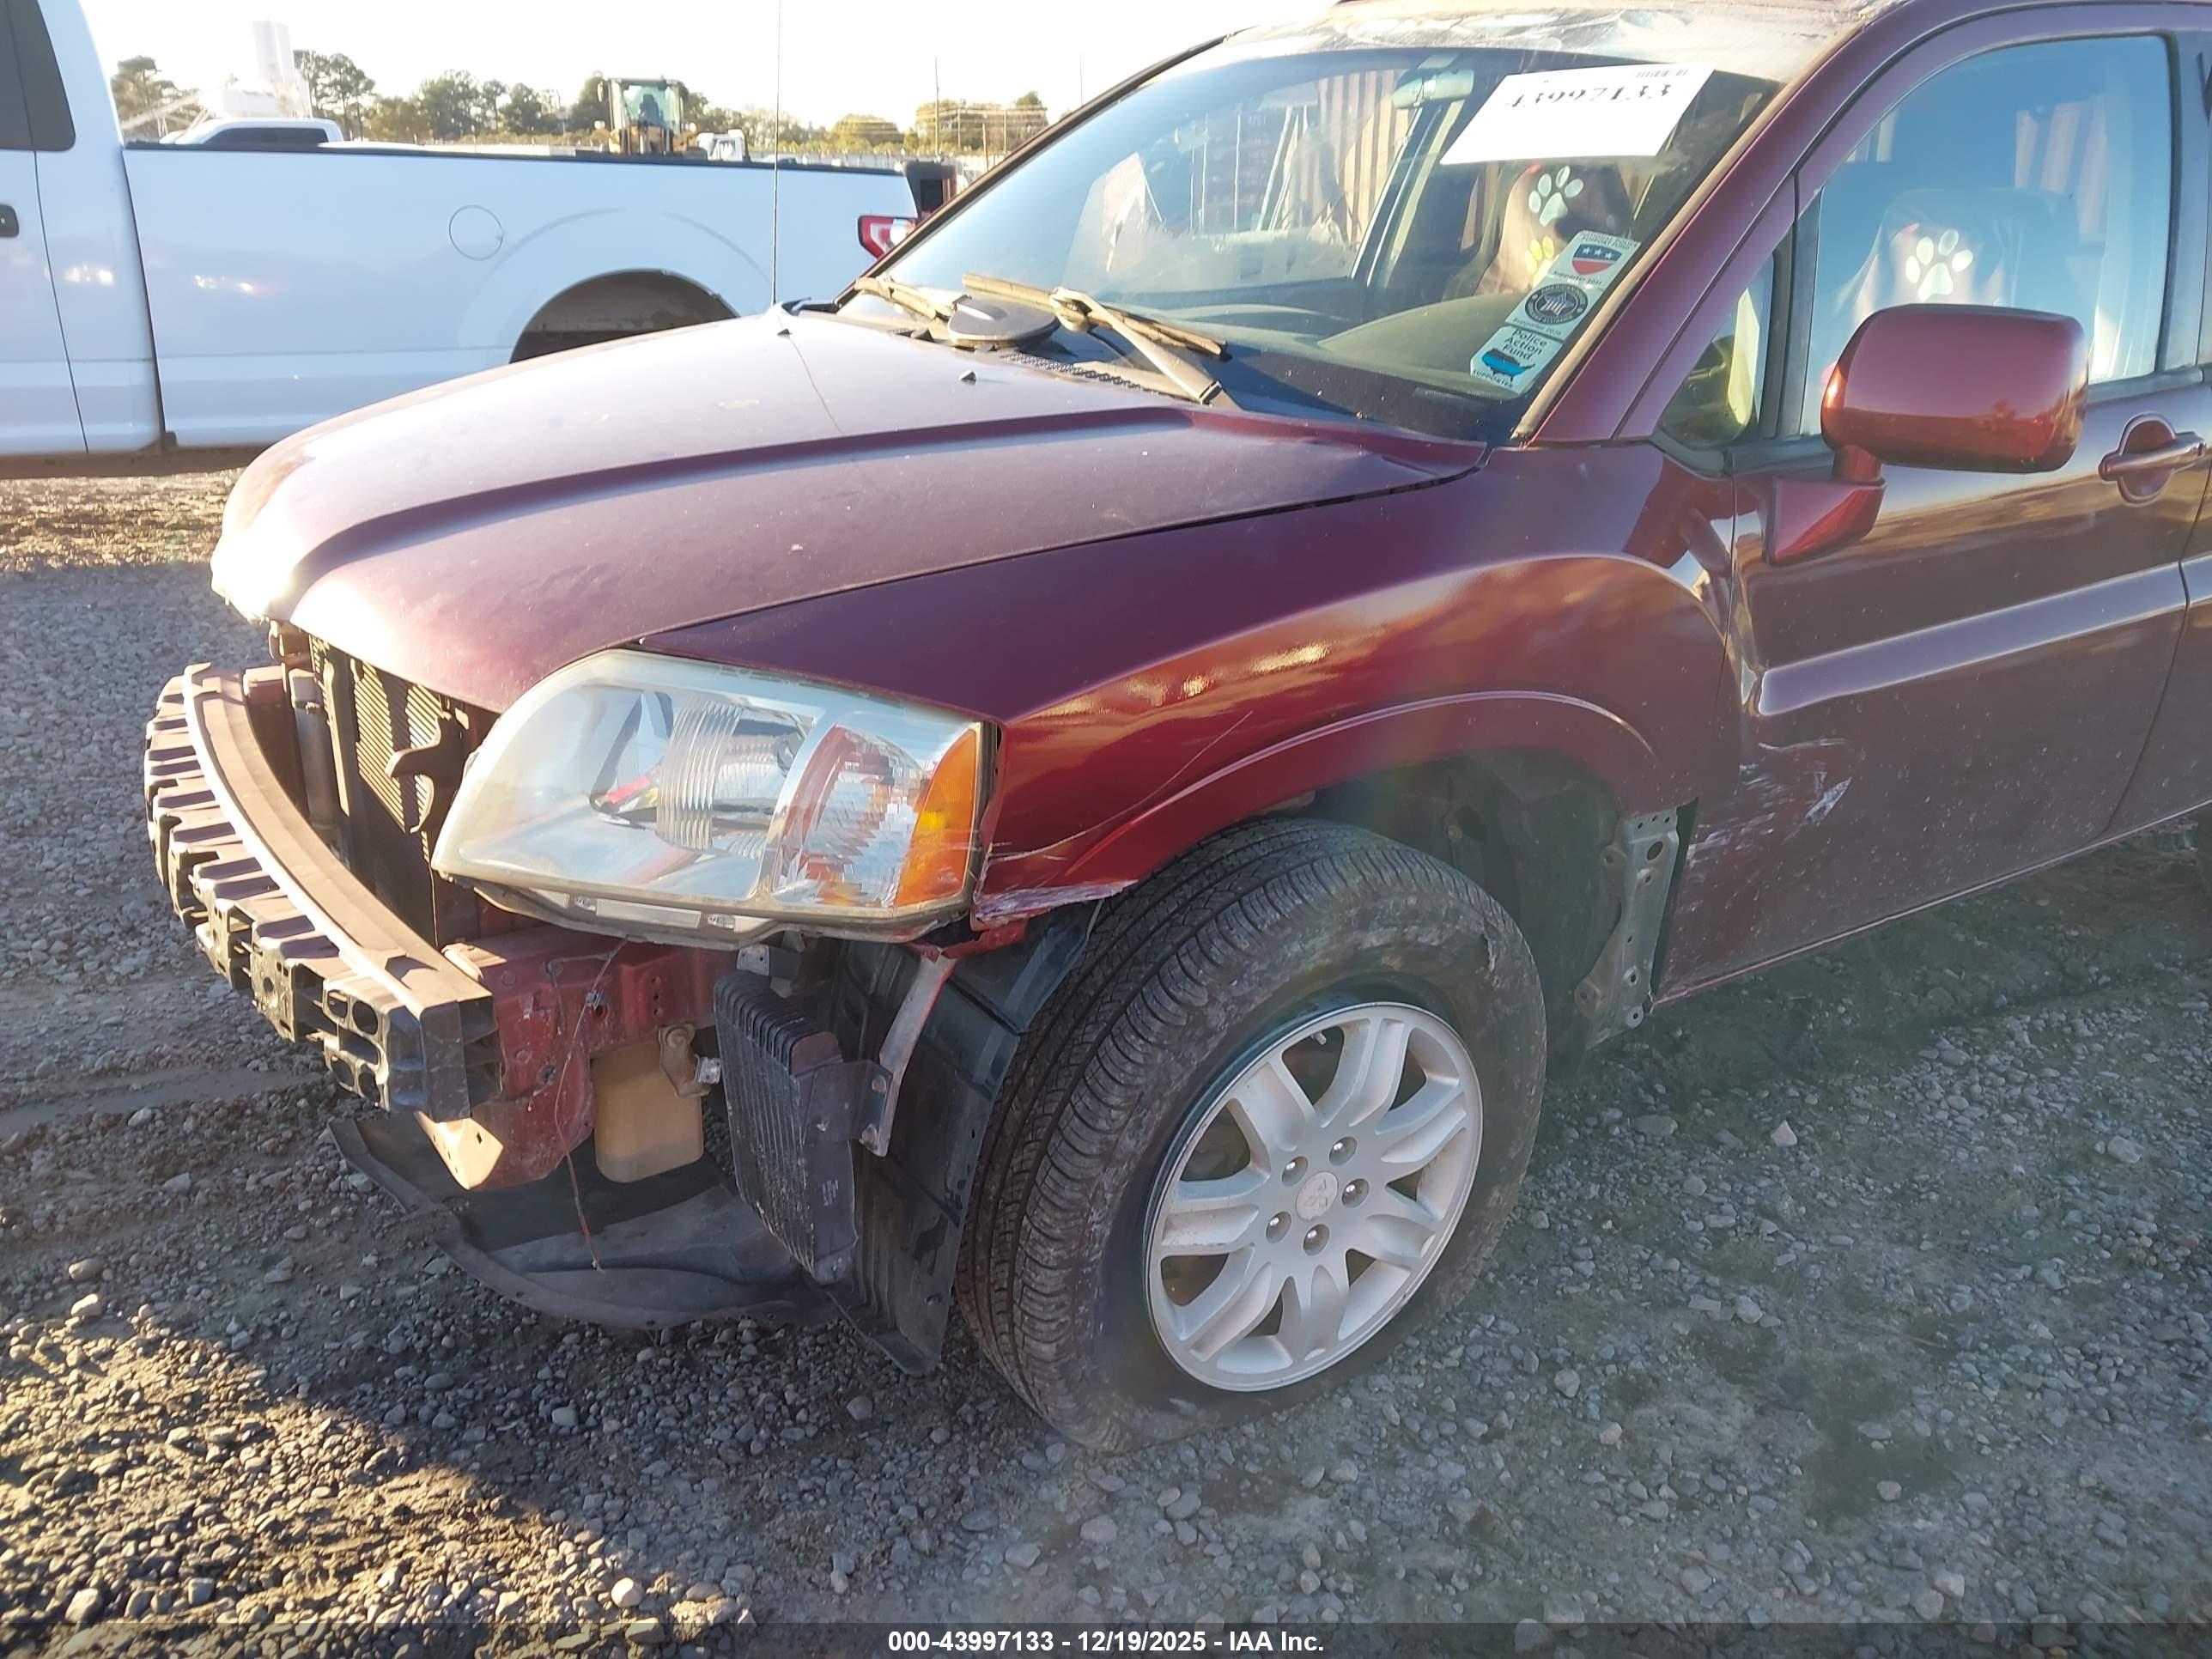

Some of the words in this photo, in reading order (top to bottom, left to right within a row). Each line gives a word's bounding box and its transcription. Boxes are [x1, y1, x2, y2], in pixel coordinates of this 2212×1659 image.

[1504, 337, 1543, 356] Action
[1512, 329, 1547, 347] Police
[1502, 344, 1533, 360] Fund
